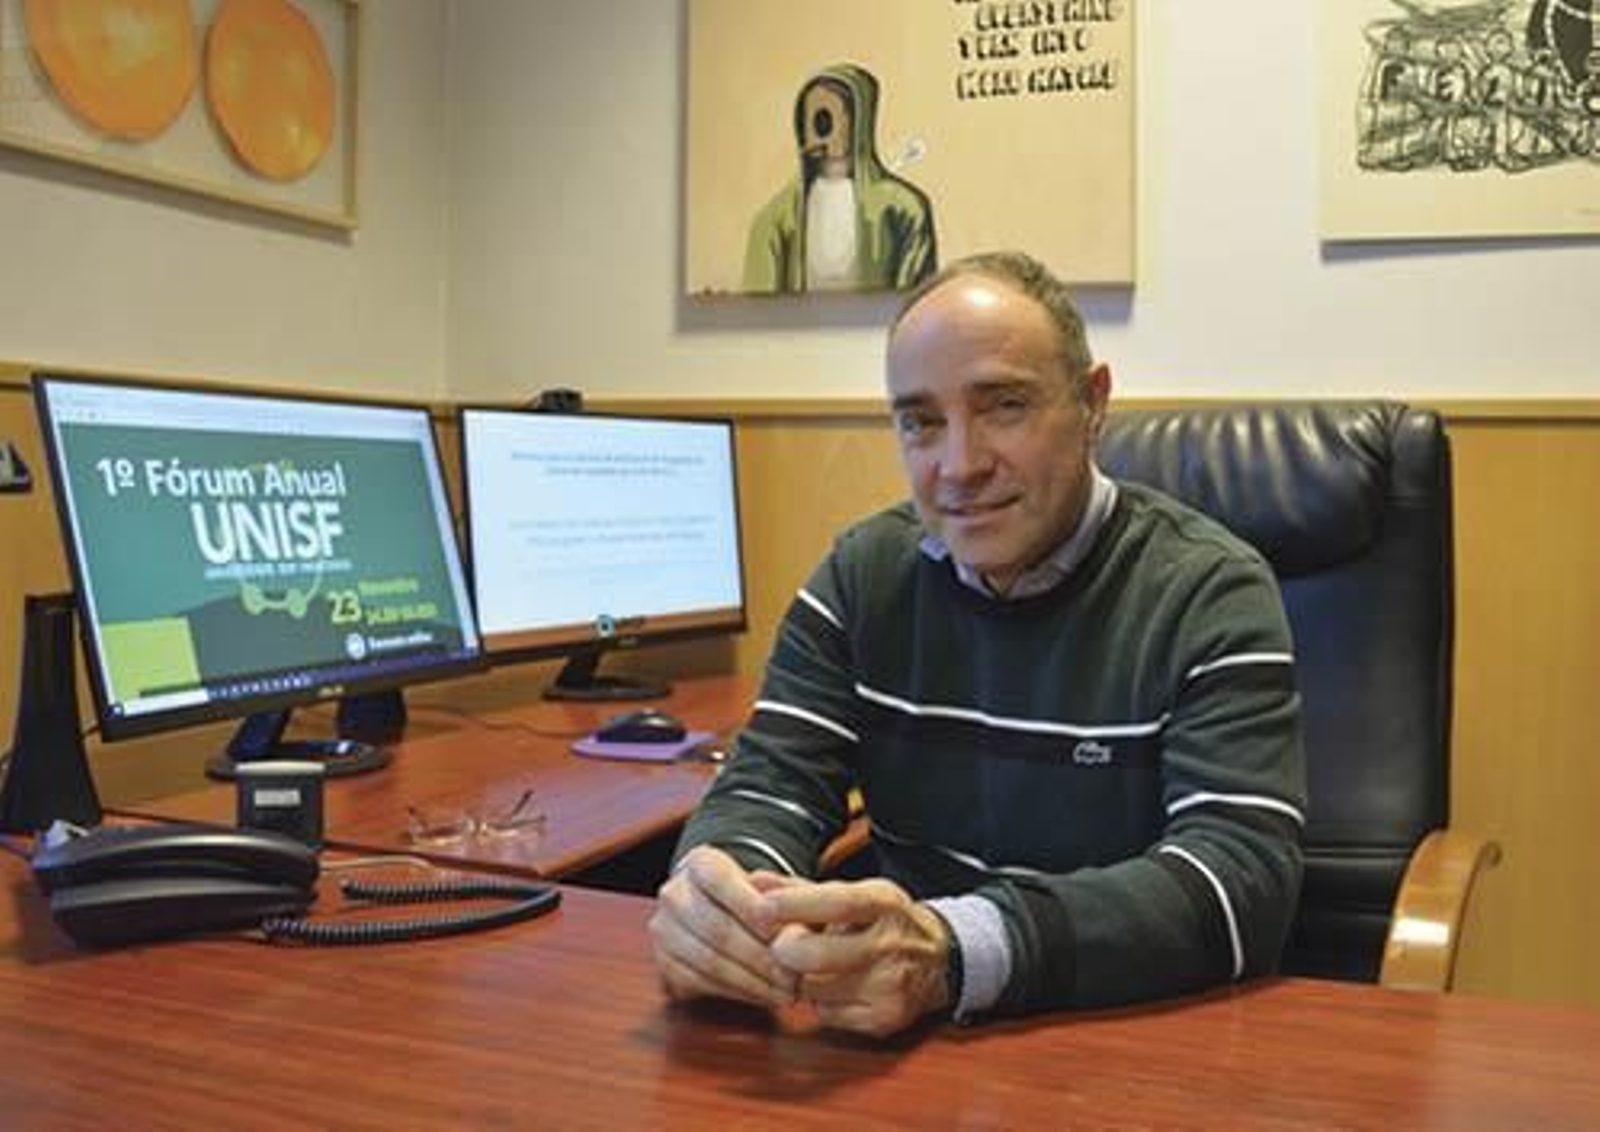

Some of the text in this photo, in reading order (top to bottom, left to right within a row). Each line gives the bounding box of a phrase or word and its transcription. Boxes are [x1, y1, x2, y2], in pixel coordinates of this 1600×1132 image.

[145, 457, 256, 496] Fórum
[264, 461, 347, 496] Anual
[190, 502, 343, 564] UNISF
[327, 589, 361, 624] 23
